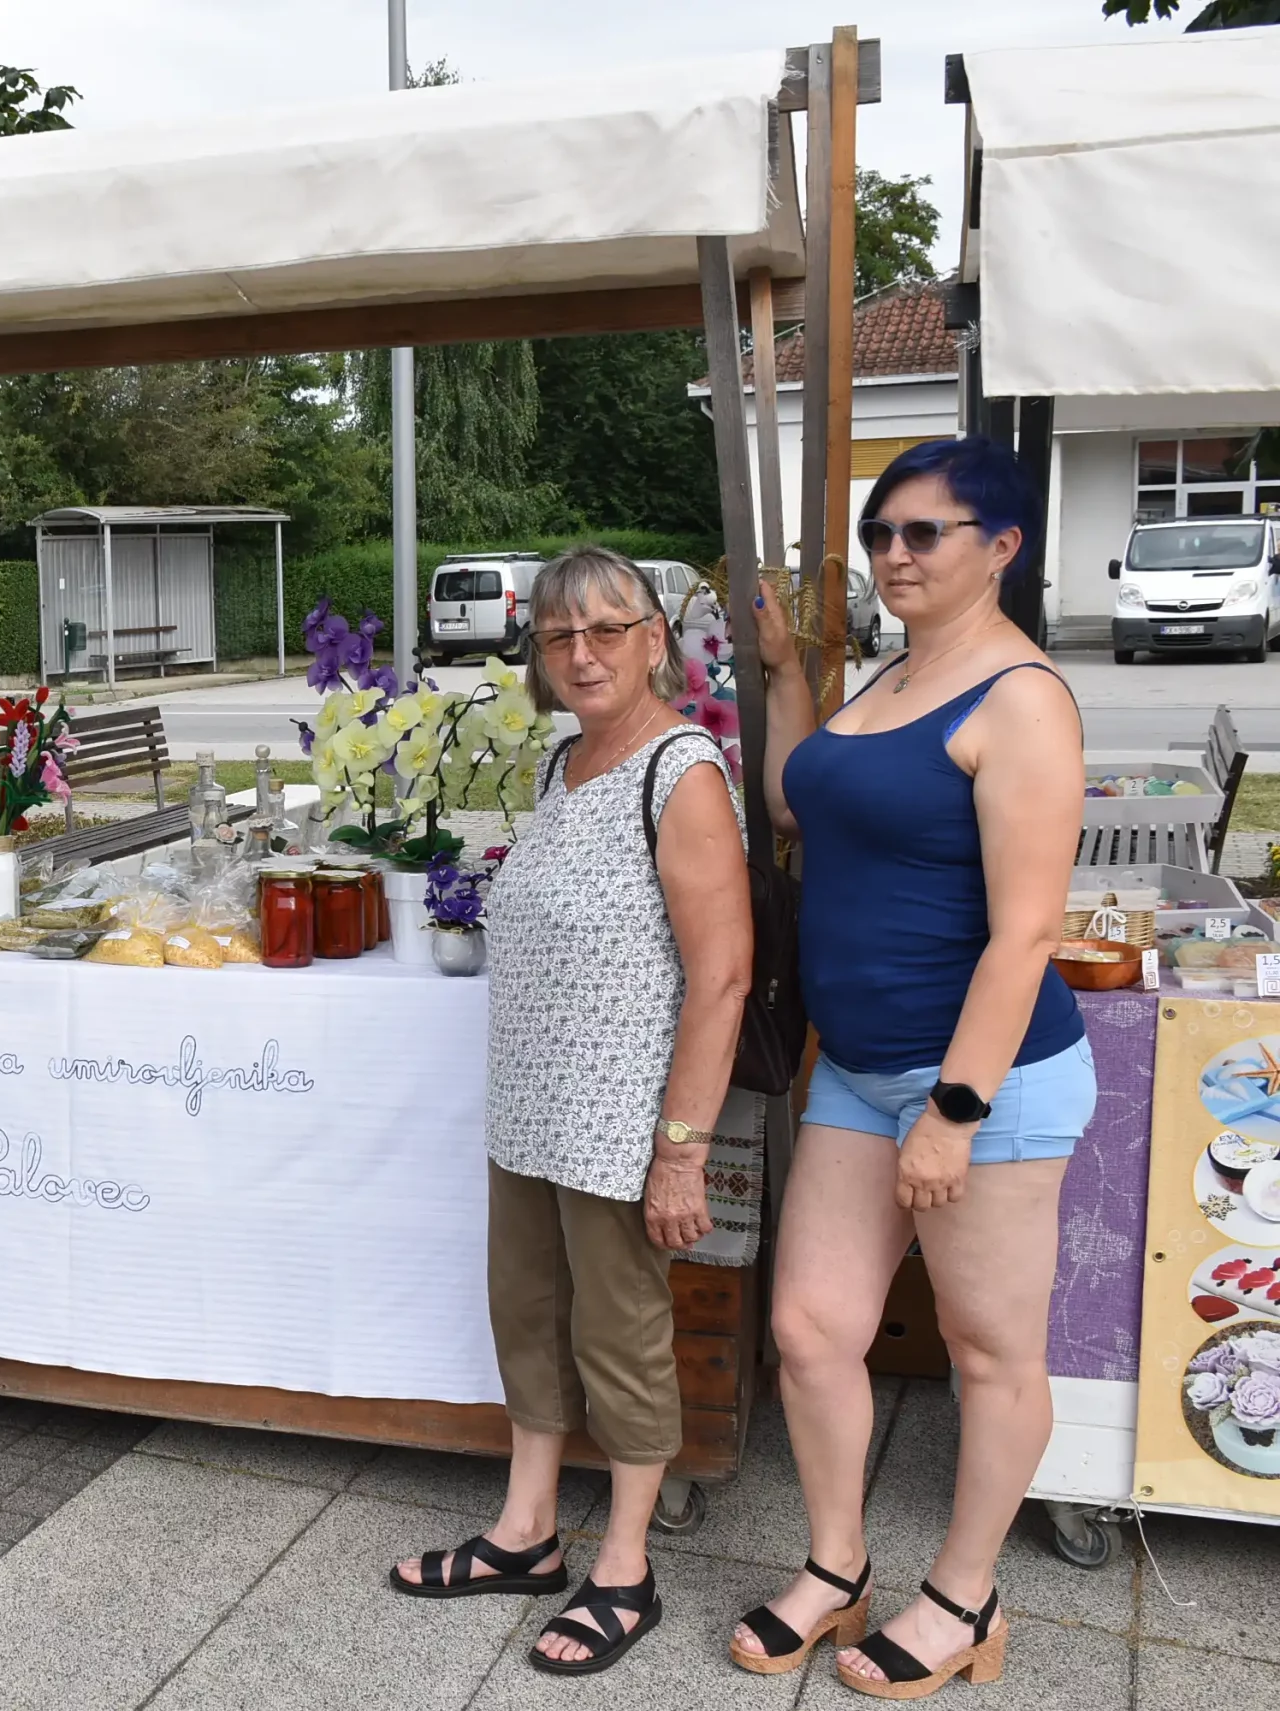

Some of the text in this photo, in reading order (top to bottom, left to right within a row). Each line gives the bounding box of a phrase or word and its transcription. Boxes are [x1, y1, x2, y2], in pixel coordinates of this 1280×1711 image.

[1210, 918, 1226, 929] 2,5
[1147, 951, 1153, 961] 2
[1261, 955, 1280, 966] 1,5
[47, 1034, 315, 1117] umirovljenika
